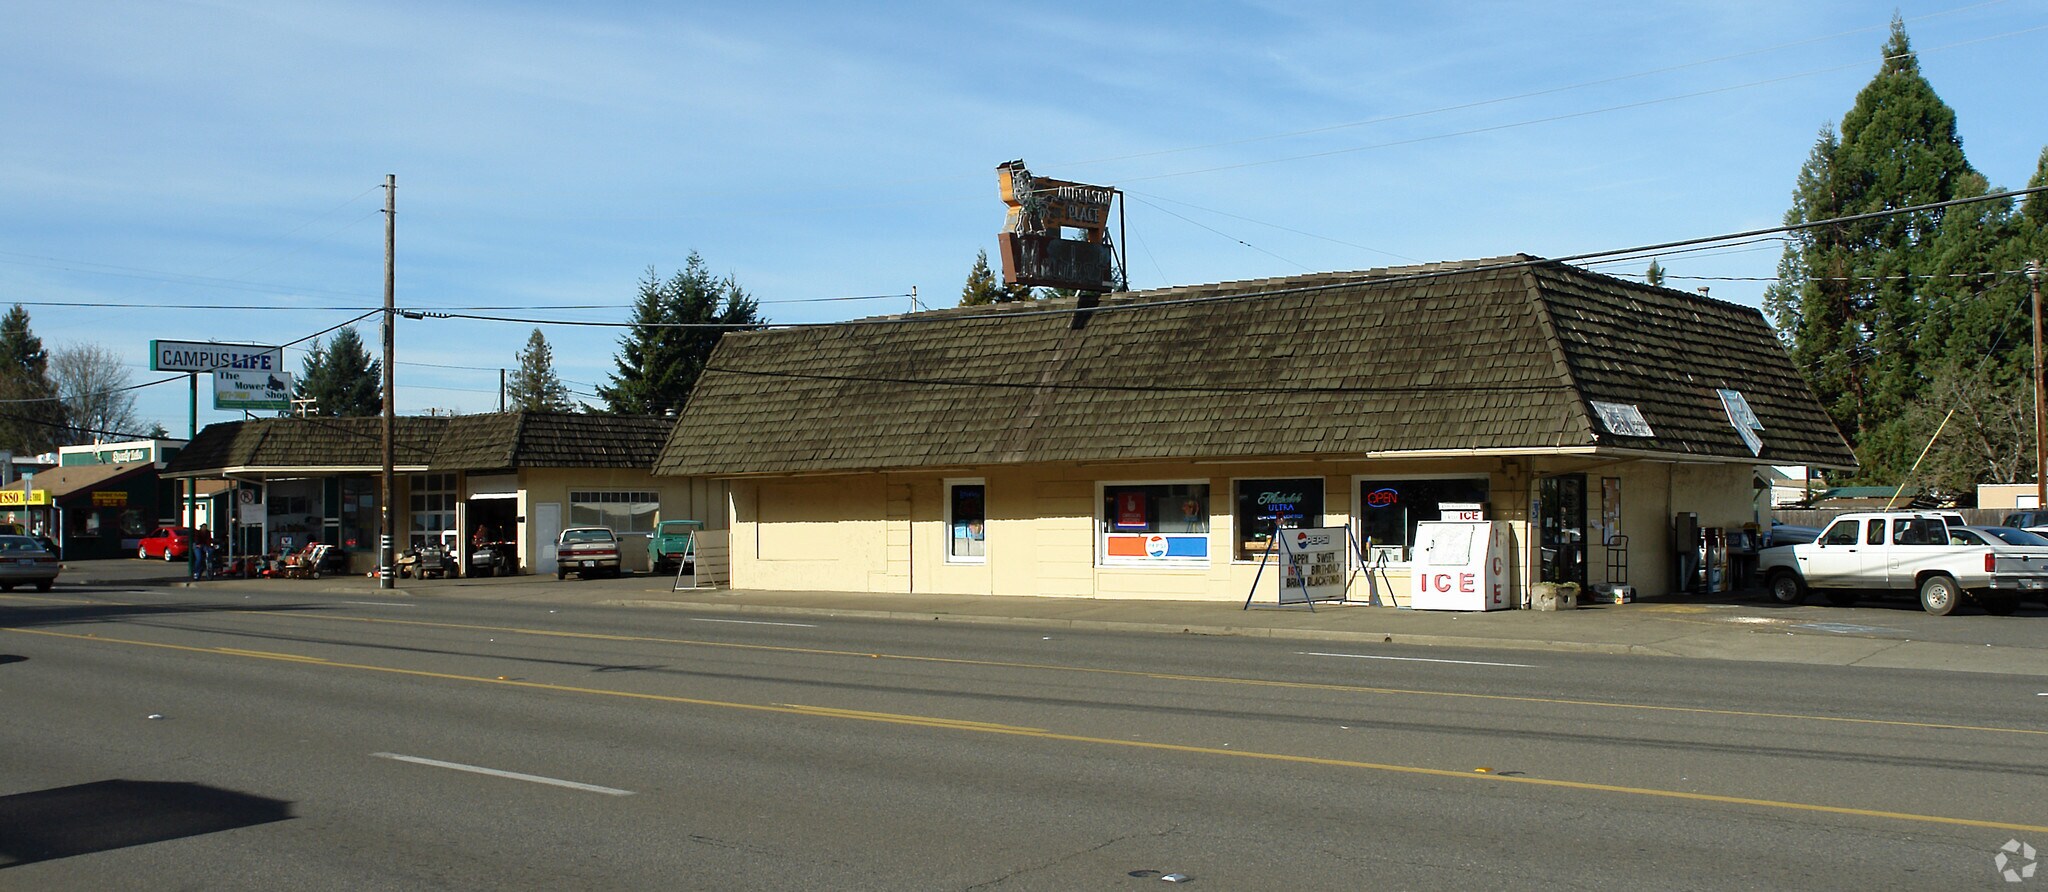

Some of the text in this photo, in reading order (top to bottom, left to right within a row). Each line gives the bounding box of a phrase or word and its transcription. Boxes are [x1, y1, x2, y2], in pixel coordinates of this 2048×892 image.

[1058, 185, 1110, 205] ANDERSON
[1068, 204, 1099, 223] PLACE
[219, 371, 240, 381] The
[234, 381, 266, 390] Mower
[264, 390, 288, 401] Shop
[1367, 492, 1398, 504] OPEN
[1268, 503, 1295, 512] ULTRA
[1459, 511, 1479, 521] ICE
[1306, 535, 1330, 546] PEPSI
[1316, 552, 1335, 563] SWEET
[1287, 563, 1341, 576] 16TH BIRTHDAY
[1420, 573, 1475, 593] ICE
